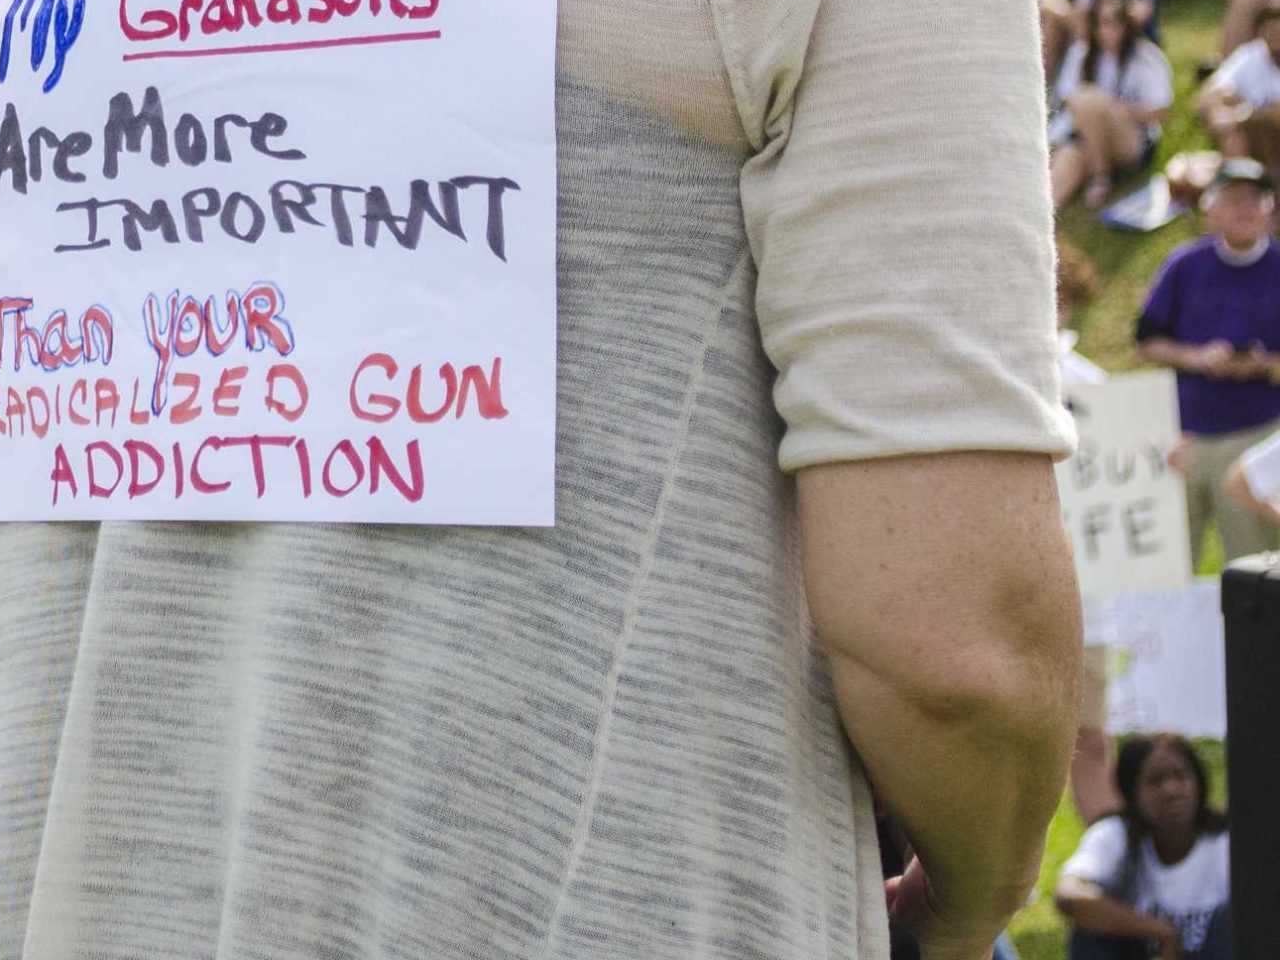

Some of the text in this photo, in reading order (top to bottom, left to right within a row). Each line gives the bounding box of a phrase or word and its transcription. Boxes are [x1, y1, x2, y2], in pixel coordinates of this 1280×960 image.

[103, 86, 306, 179] More
[53, 175, 522, 262] IMPORTANT
[349, 351, 510, 423] GUN
[52, 435, 424, 506] ADDICTION
